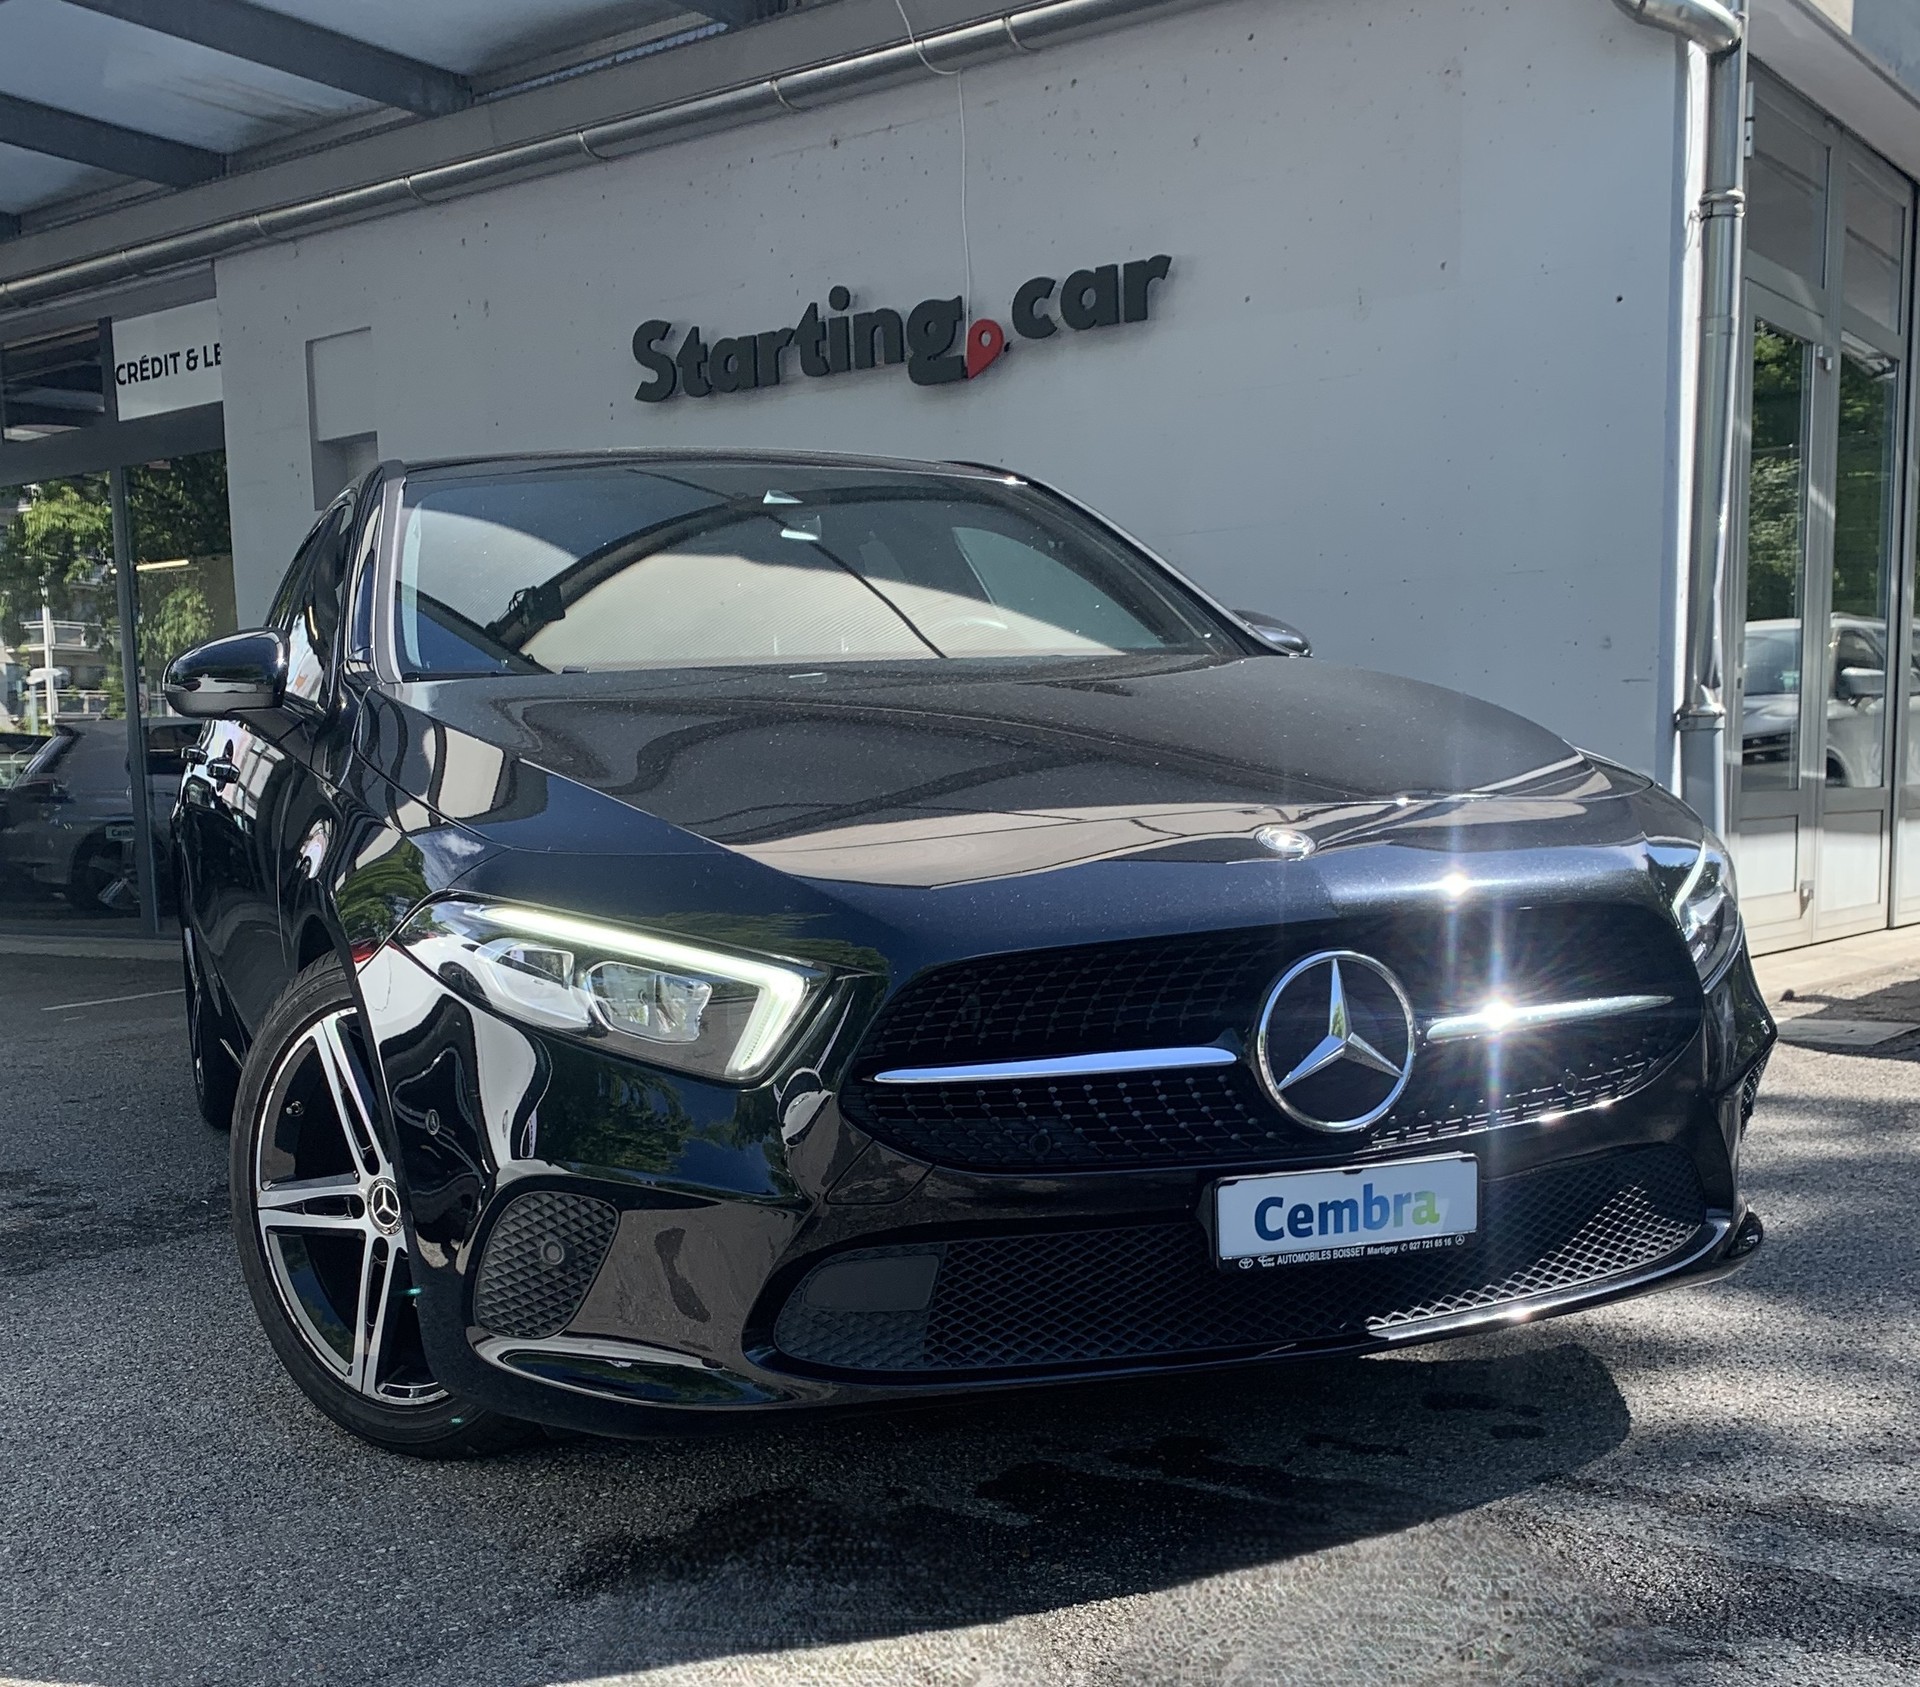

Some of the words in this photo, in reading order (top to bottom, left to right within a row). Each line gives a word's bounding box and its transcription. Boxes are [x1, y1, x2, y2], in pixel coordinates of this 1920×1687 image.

[115, 352, 180, 386] CRÉDIT
[186, 348, 199, 371] &
[1254, 1183, 1440, 1241] Cembra
[1277, 1250, 1331, 1264] AUTOMOBILES
[1332, 1247, 1364, 1258] BOISSET
[1366, 1245, 1398, 1255] Martigny
[1422, 1241, 1433, 1249] 721
